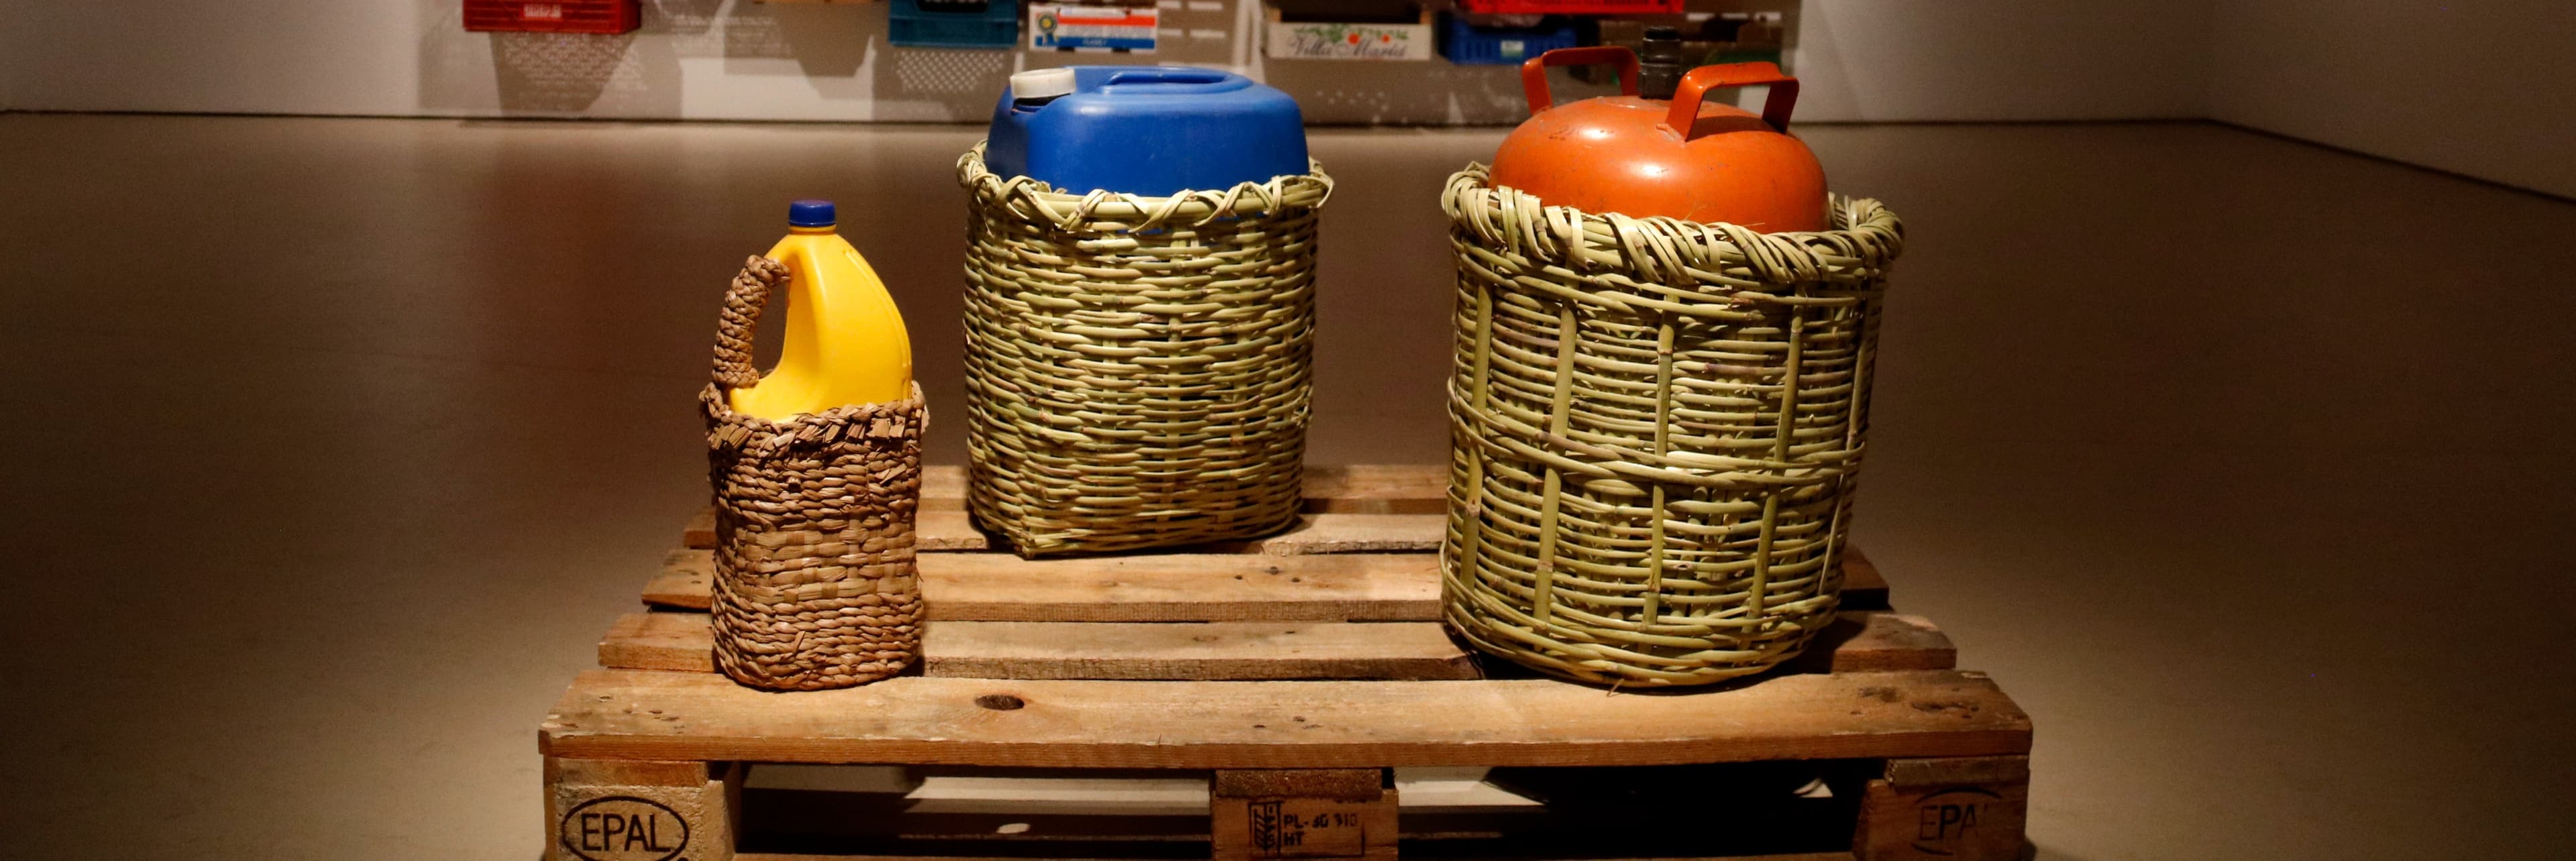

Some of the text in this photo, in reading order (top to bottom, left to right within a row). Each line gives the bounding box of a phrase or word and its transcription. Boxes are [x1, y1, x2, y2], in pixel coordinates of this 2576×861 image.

[581, 813, 672, 852] EPAL
[1283, 831, 1305, 846] HT
[1919, 803, 1989, 841] EPA
